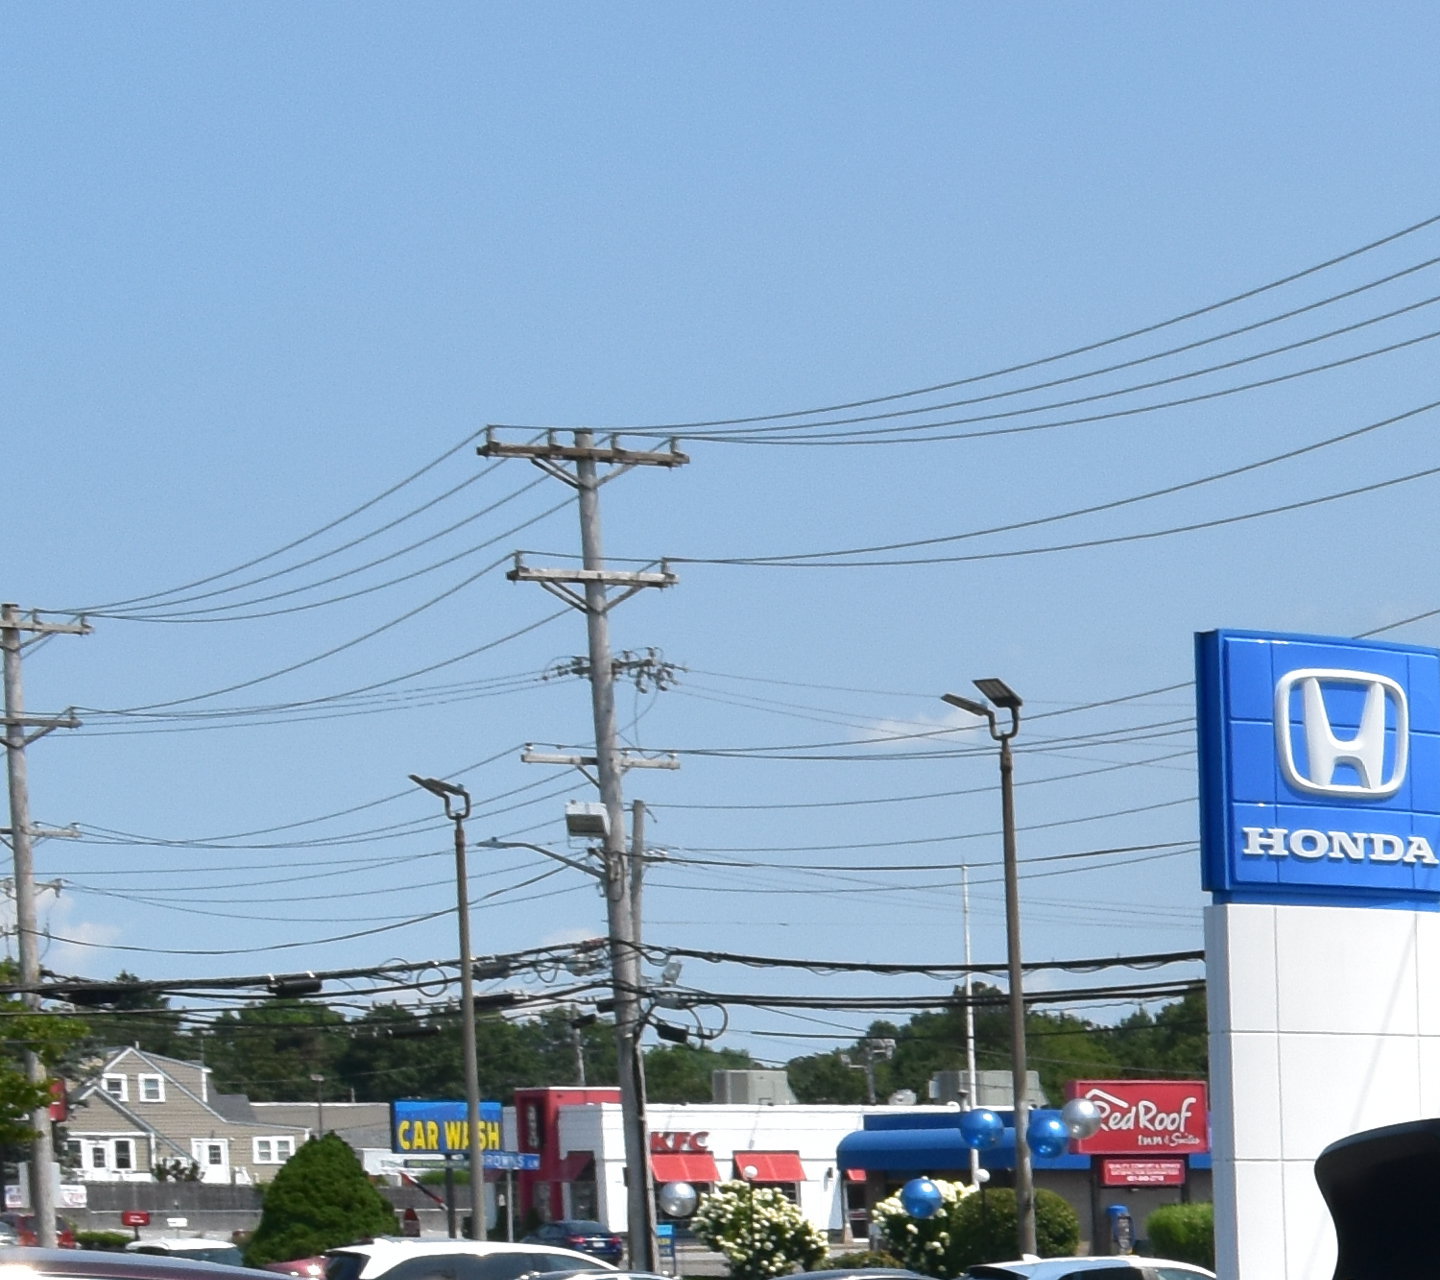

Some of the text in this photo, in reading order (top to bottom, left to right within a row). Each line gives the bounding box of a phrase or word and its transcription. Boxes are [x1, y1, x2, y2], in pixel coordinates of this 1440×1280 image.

[1242, 826, 1440, 864] HONDA
[1138, 1097, 1197, 1132] Roof
[398, 1120, 439, 1150] CAR
[651, 1131, 709, 1151] KFC
[1138, 1134, 1162, 1146] Inn
